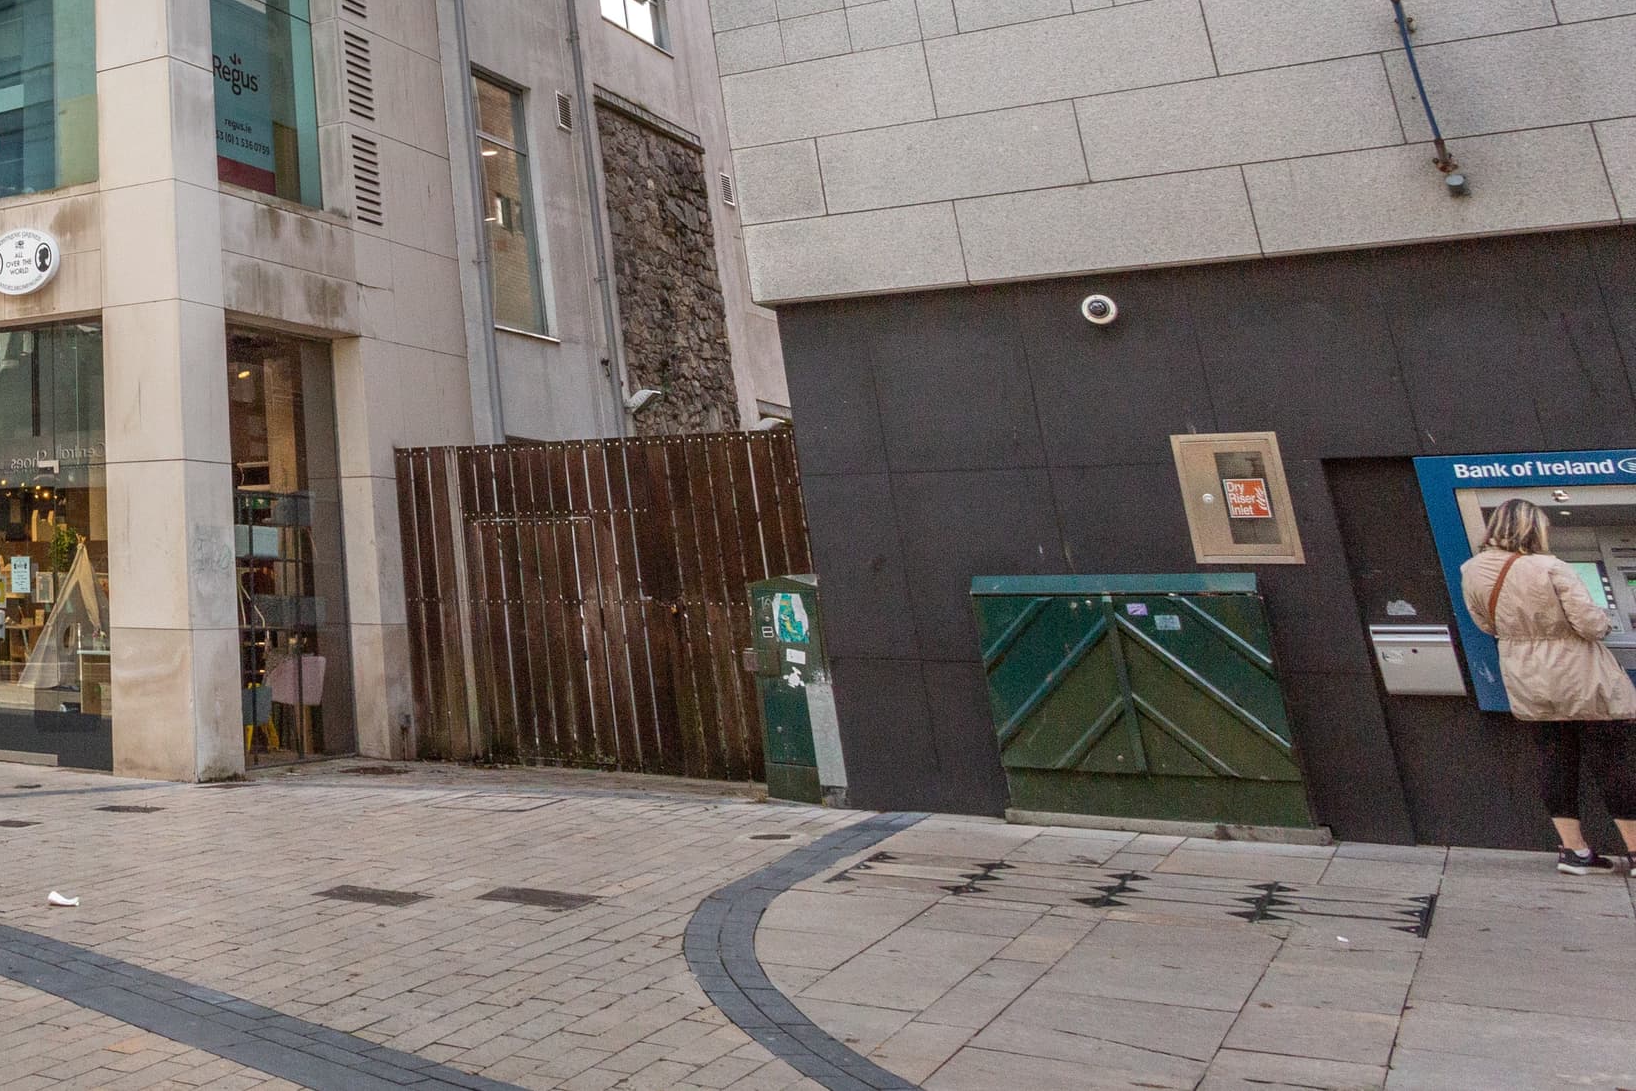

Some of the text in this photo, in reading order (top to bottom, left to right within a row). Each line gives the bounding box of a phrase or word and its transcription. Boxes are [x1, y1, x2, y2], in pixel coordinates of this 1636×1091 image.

[212, 54, 258, 95] Regus
[224, 119, 252, 134] regus.ie
[6, 260, 20, 268] OVER
[10, 267, 29, 275] WORLD
[1453, 459, 1615, 479] Bank of Ireland
[1226, 481, 1244, 495] Dry
[1228, 493, 1255, 504] Riser
[1231, 505, 1254, 516] Inlet
